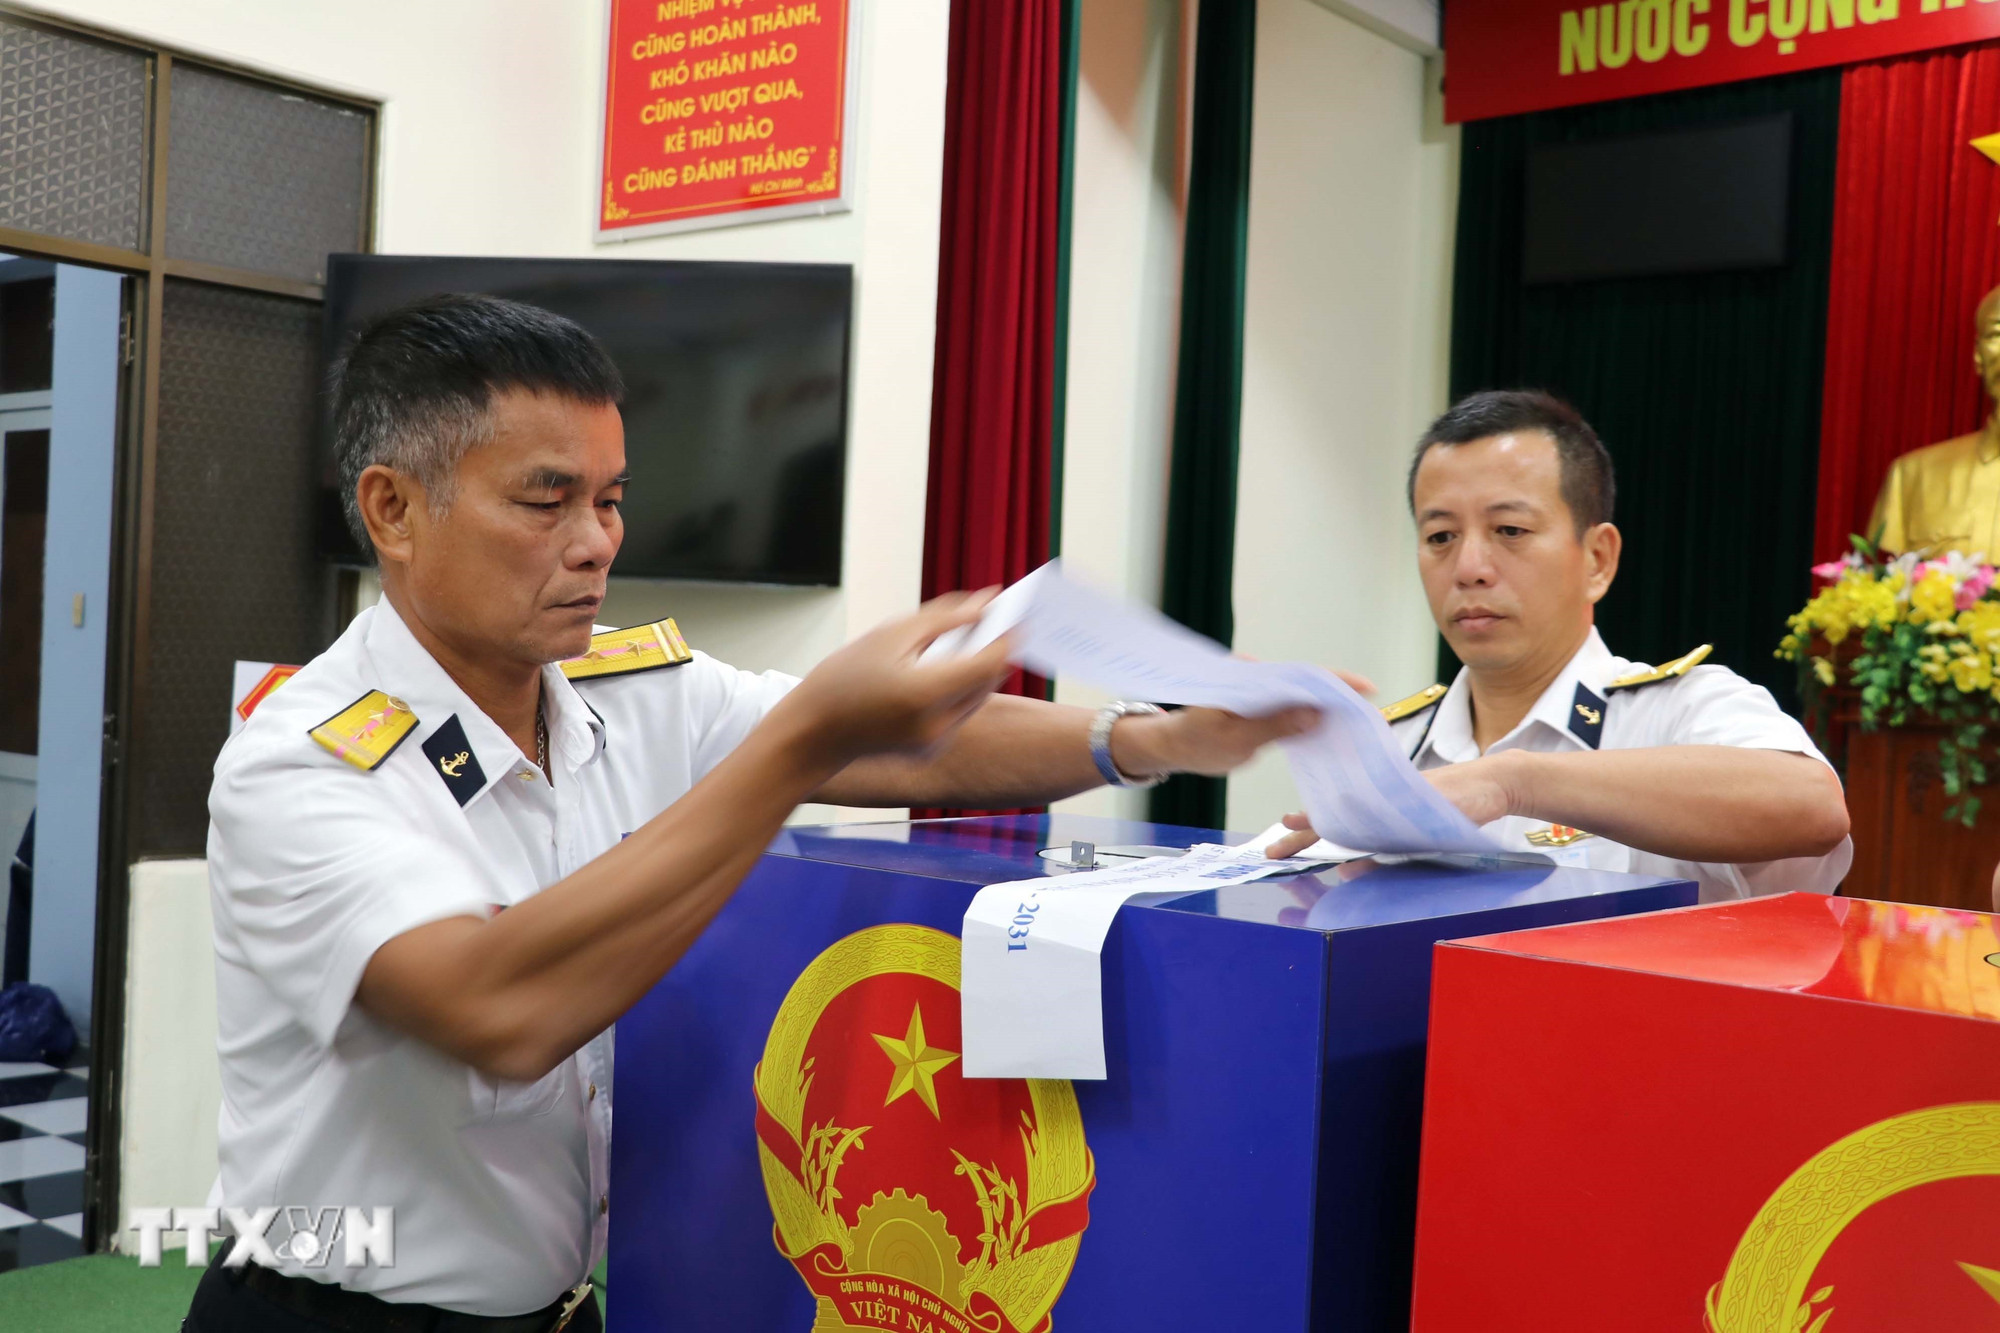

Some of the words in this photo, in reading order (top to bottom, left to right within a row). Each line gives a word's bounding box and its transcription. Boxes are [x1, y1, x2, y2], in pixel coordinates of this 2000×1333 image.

[632, 32, 686, 60] CŨNG
[690, 17, 746, 49] HOÀN
[751, 3, 821, 36] THÀNH,
[650, 59, 689, 90] KHÓ
[693, 51, 746, 81] KHĂN
[751, 41, 797, 71] NÀO
[640, 97, 695, 125] CŨNG
[754, 78, 804, 104] QUA,
[664, 125, 686, 154] KẺ
[728, 115, 774, 143] NÀO
[624, 167, 677, 193] CŨNG
[682, 157, 736, 184] ĐÁNH
[1008, 903, 1040, 954] 2031
[840, 1279, 864, 1294] CỘNG
[866, 1279, 885, 1293] HÒA
[888, 1284, 900, 1298] XÃ
[903, 1289, 919, 1305] HỘI
[921, 1298, 941, 1315] CHỦ
[942, 1310, 970, 1333] NGHĨA
[850, 1298, 900, 1324] VIỆT
[906, 1311, 946, 1333] NA
